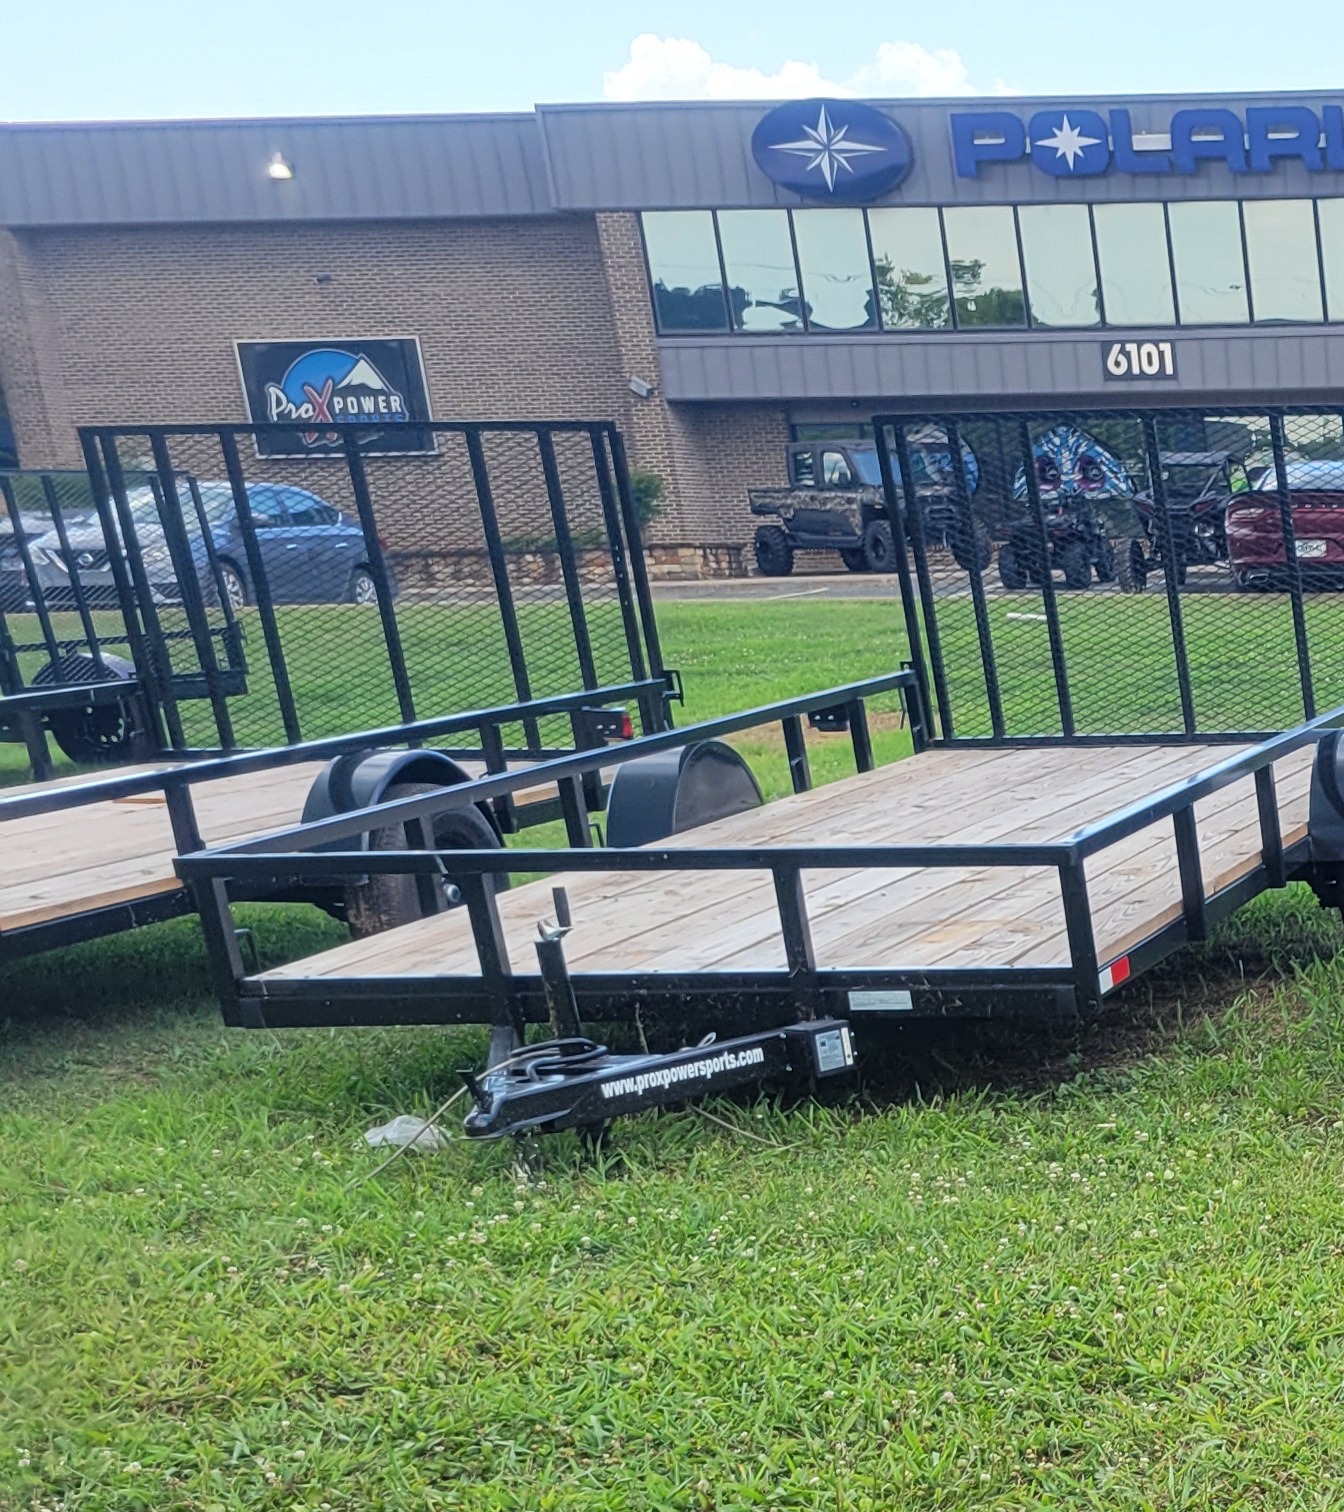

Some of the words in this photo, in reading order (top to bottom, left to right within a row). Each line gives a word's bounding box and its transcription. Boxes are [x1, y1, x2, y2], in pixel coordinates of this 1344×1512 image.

[1106, 341, 1174, 376] 6101
[333, 395, 402, 414] POWER
[601, 1047, 765, 1099] www.proxpowersports.com
